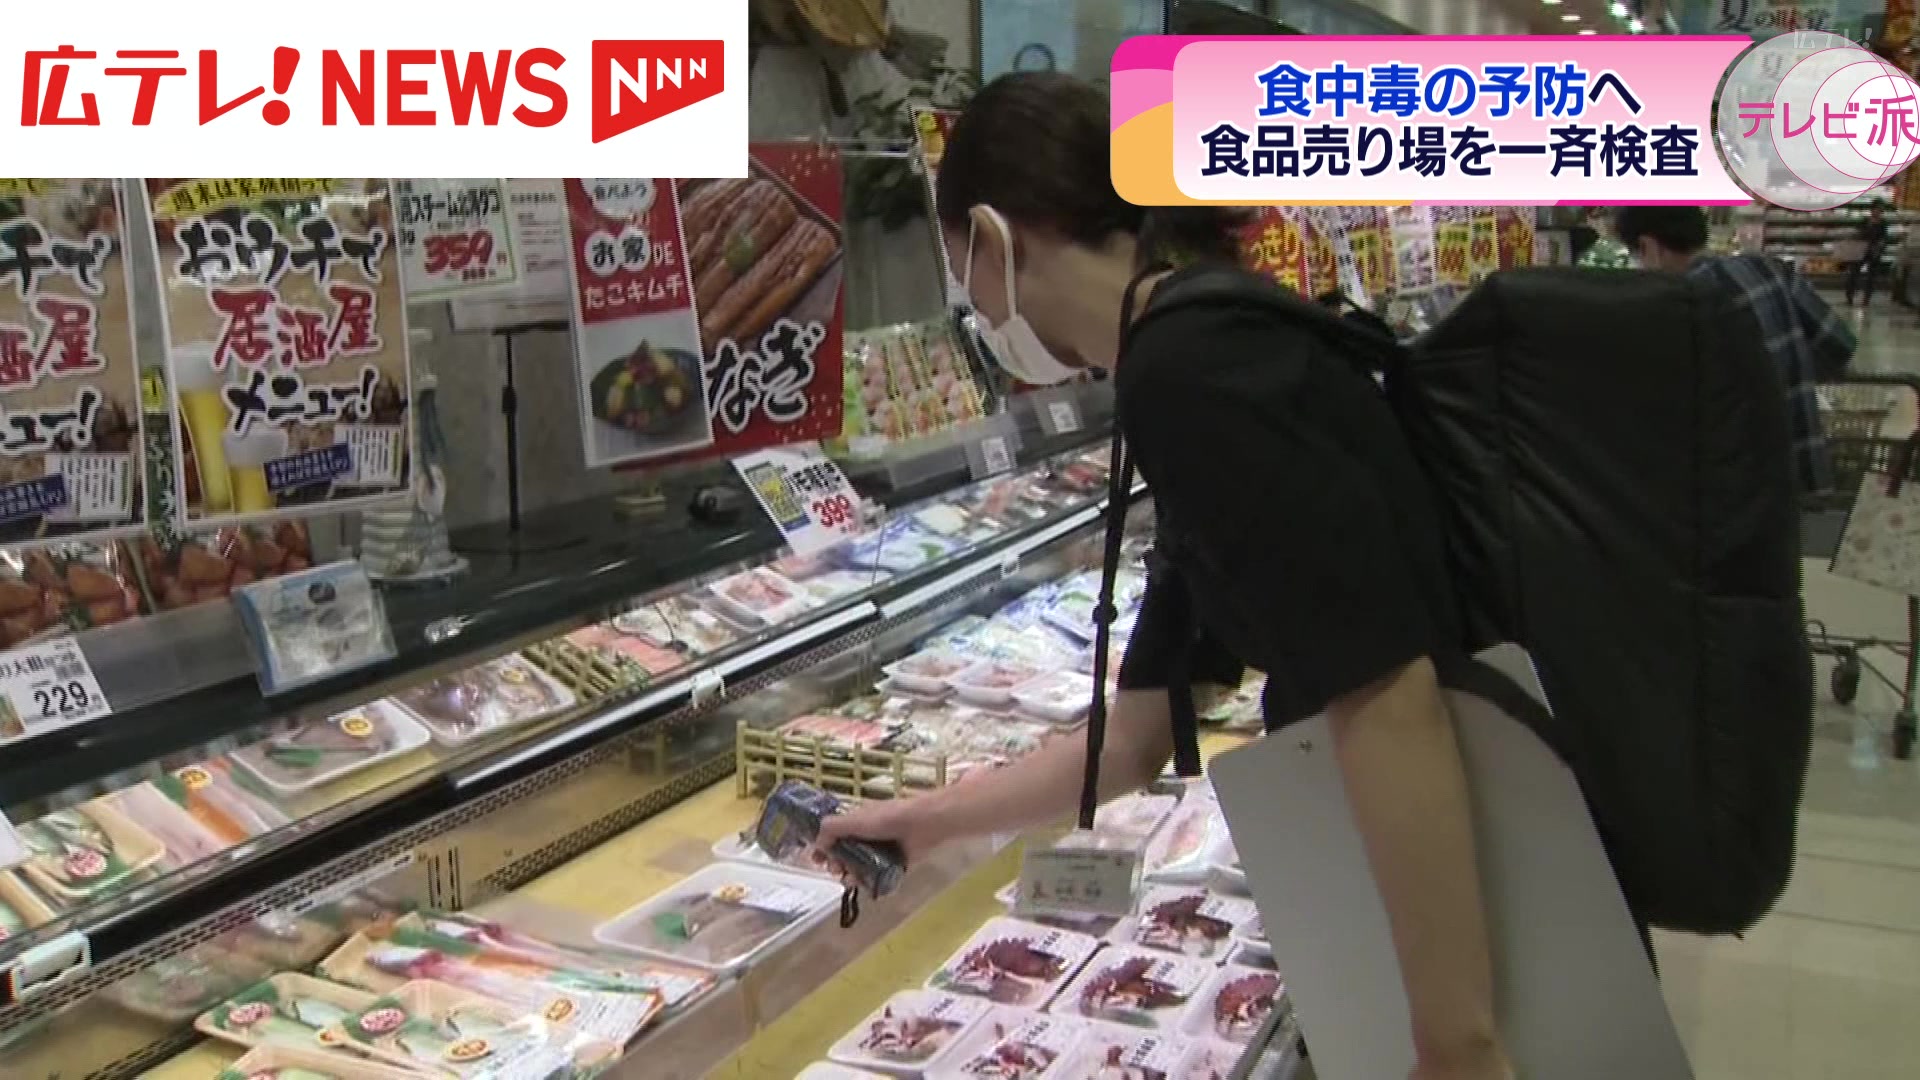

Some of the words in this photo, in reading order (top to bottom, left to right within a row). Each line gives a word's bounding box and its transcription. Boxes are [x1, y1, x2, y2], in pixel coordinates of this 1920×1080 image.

[179, 221, 383, 284] おウチで
[423, 229, 493, 274] 359
[585, 273, 684, 310] たこキムチ
[211, 285, 380, 368] 居酒屋
[228, 371, 375, 433] メニュー!
[811, 494, 850, 527] 399
[34, 681, 89, 717] 229
